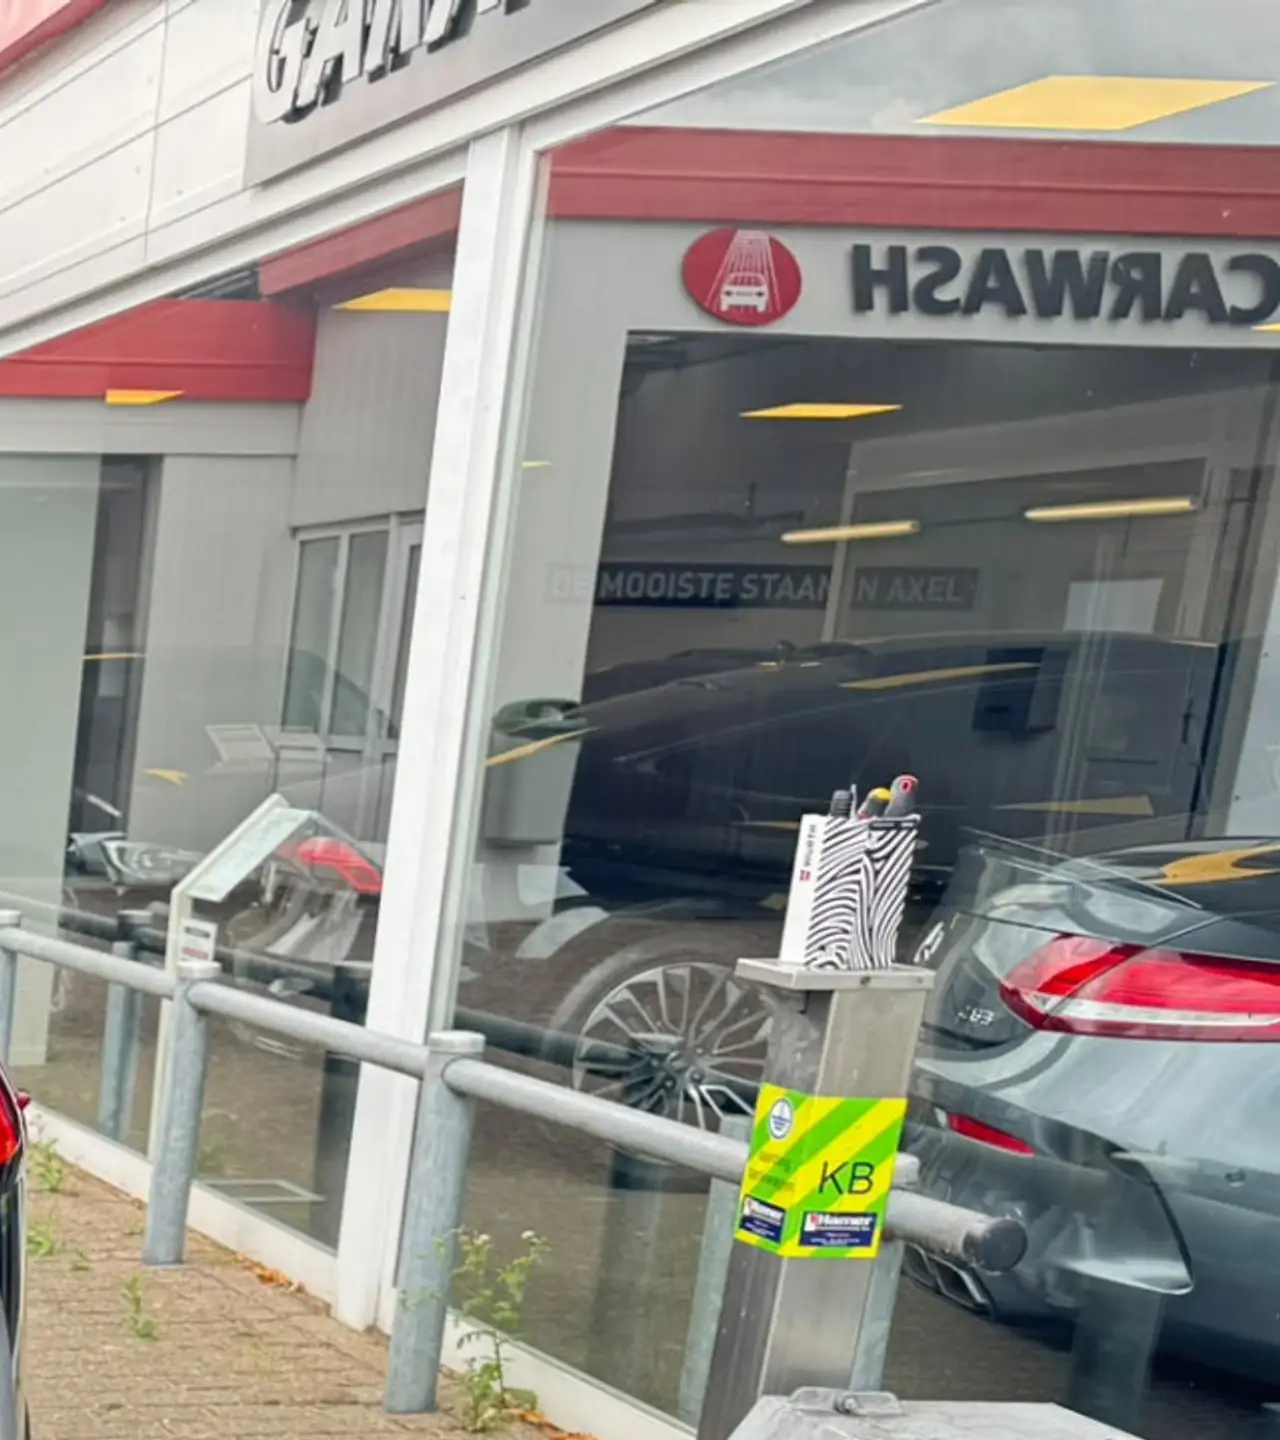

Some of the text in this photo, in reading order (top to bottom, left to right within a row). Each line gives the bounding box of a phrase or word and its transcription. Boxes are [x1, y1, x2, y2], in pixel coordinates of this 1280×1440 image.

[601, 571, 734, 599] MOOISTE
[885, 574, 964, 603] AXEL
[818, 1160, 875, 1195] KB
